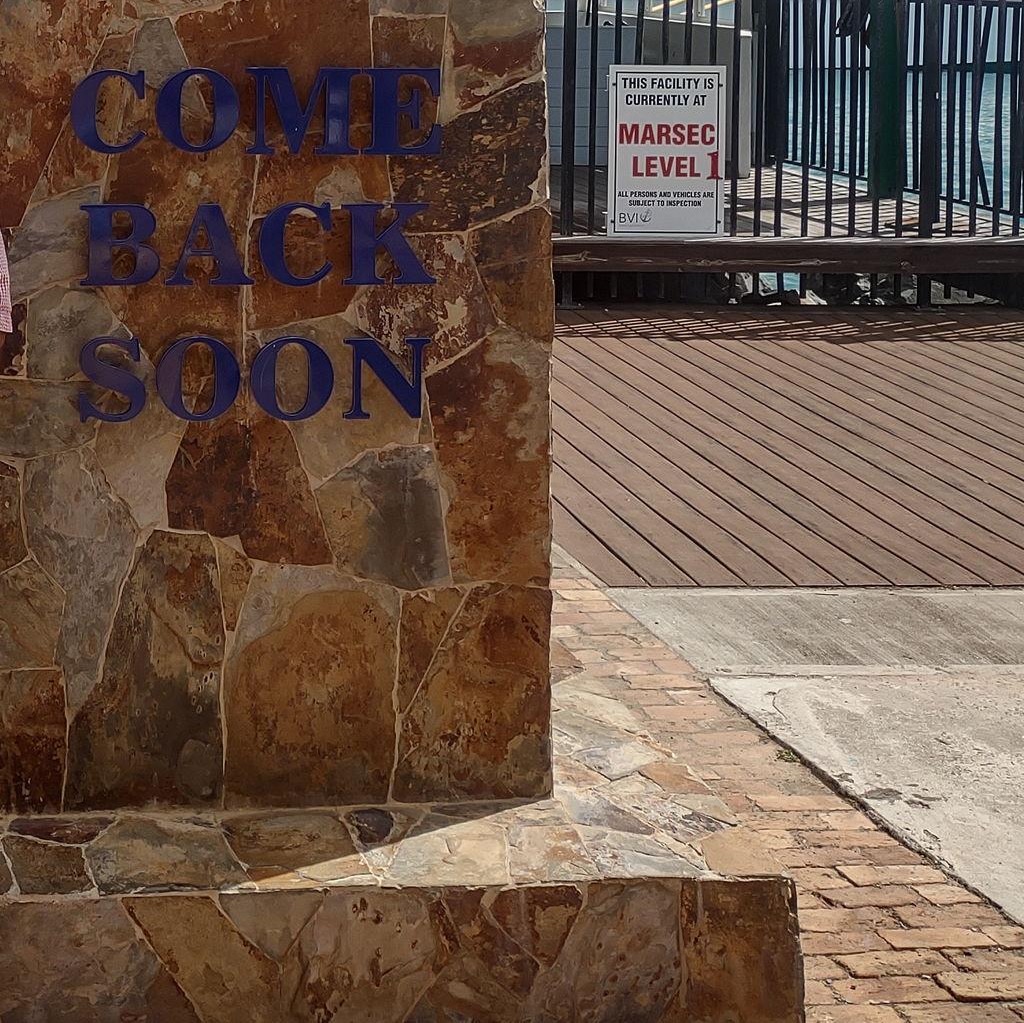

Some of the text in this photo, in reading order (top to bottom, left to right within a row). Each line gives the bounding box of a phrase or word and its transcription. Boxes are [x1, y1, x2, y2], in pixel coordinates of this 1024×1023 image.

[622, 77, 714, 89] THIS FACILITY IS
[70, 66, 443, 156] COME
[625, 94, 707, 106] CURRENTLY AT
[619, 123, 716, 146] MARSEC
[632, 151, 723, 180] LEVEL 1
[628, 199, 656, 207] SUBJECT
[703, 191, 715, 199] ARE
[79, 202, 437, 287] BACK
[79, 335, 432, 423] SOON
